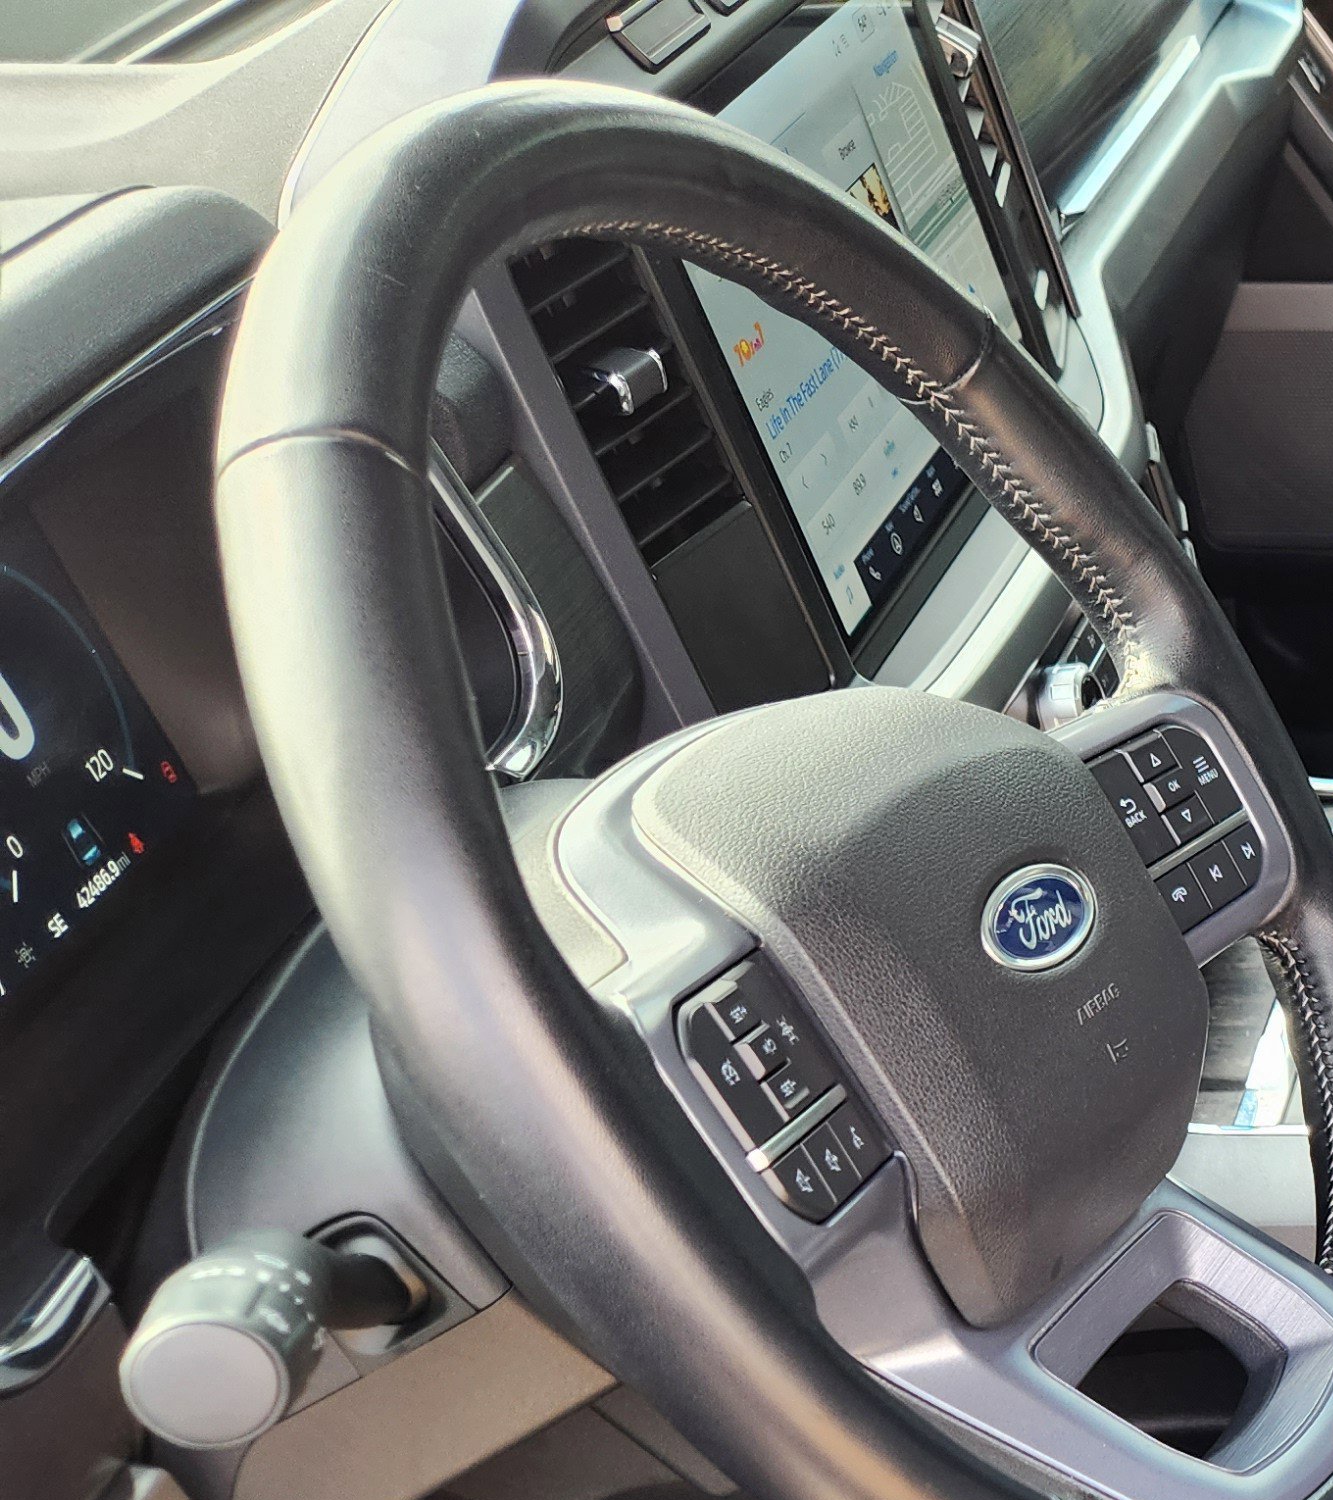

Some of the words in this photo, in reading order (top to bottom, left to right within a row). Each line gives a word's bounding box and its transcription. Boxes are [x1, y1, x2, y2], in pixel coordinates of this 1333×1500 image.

[766, 413, 784, 440] Life
[779, 406, 792, 426] In
[786, 393, 804, 416] The
[800, 373, 819, 402] Fast
[813, 357, 834, 385] Lane
[26, 761, 50, 788] MPH
[85, 749, 114, 783] 120
[1197, 768, 1219, 786] MENU
[1168, 780, 1181, 792] OK
[1125, 809, 1147, 828] BACK
[6, 835, 23, 859] 0
[48, 913, 68, 938] SE
[1008, 887, 1072, 950] Ford
